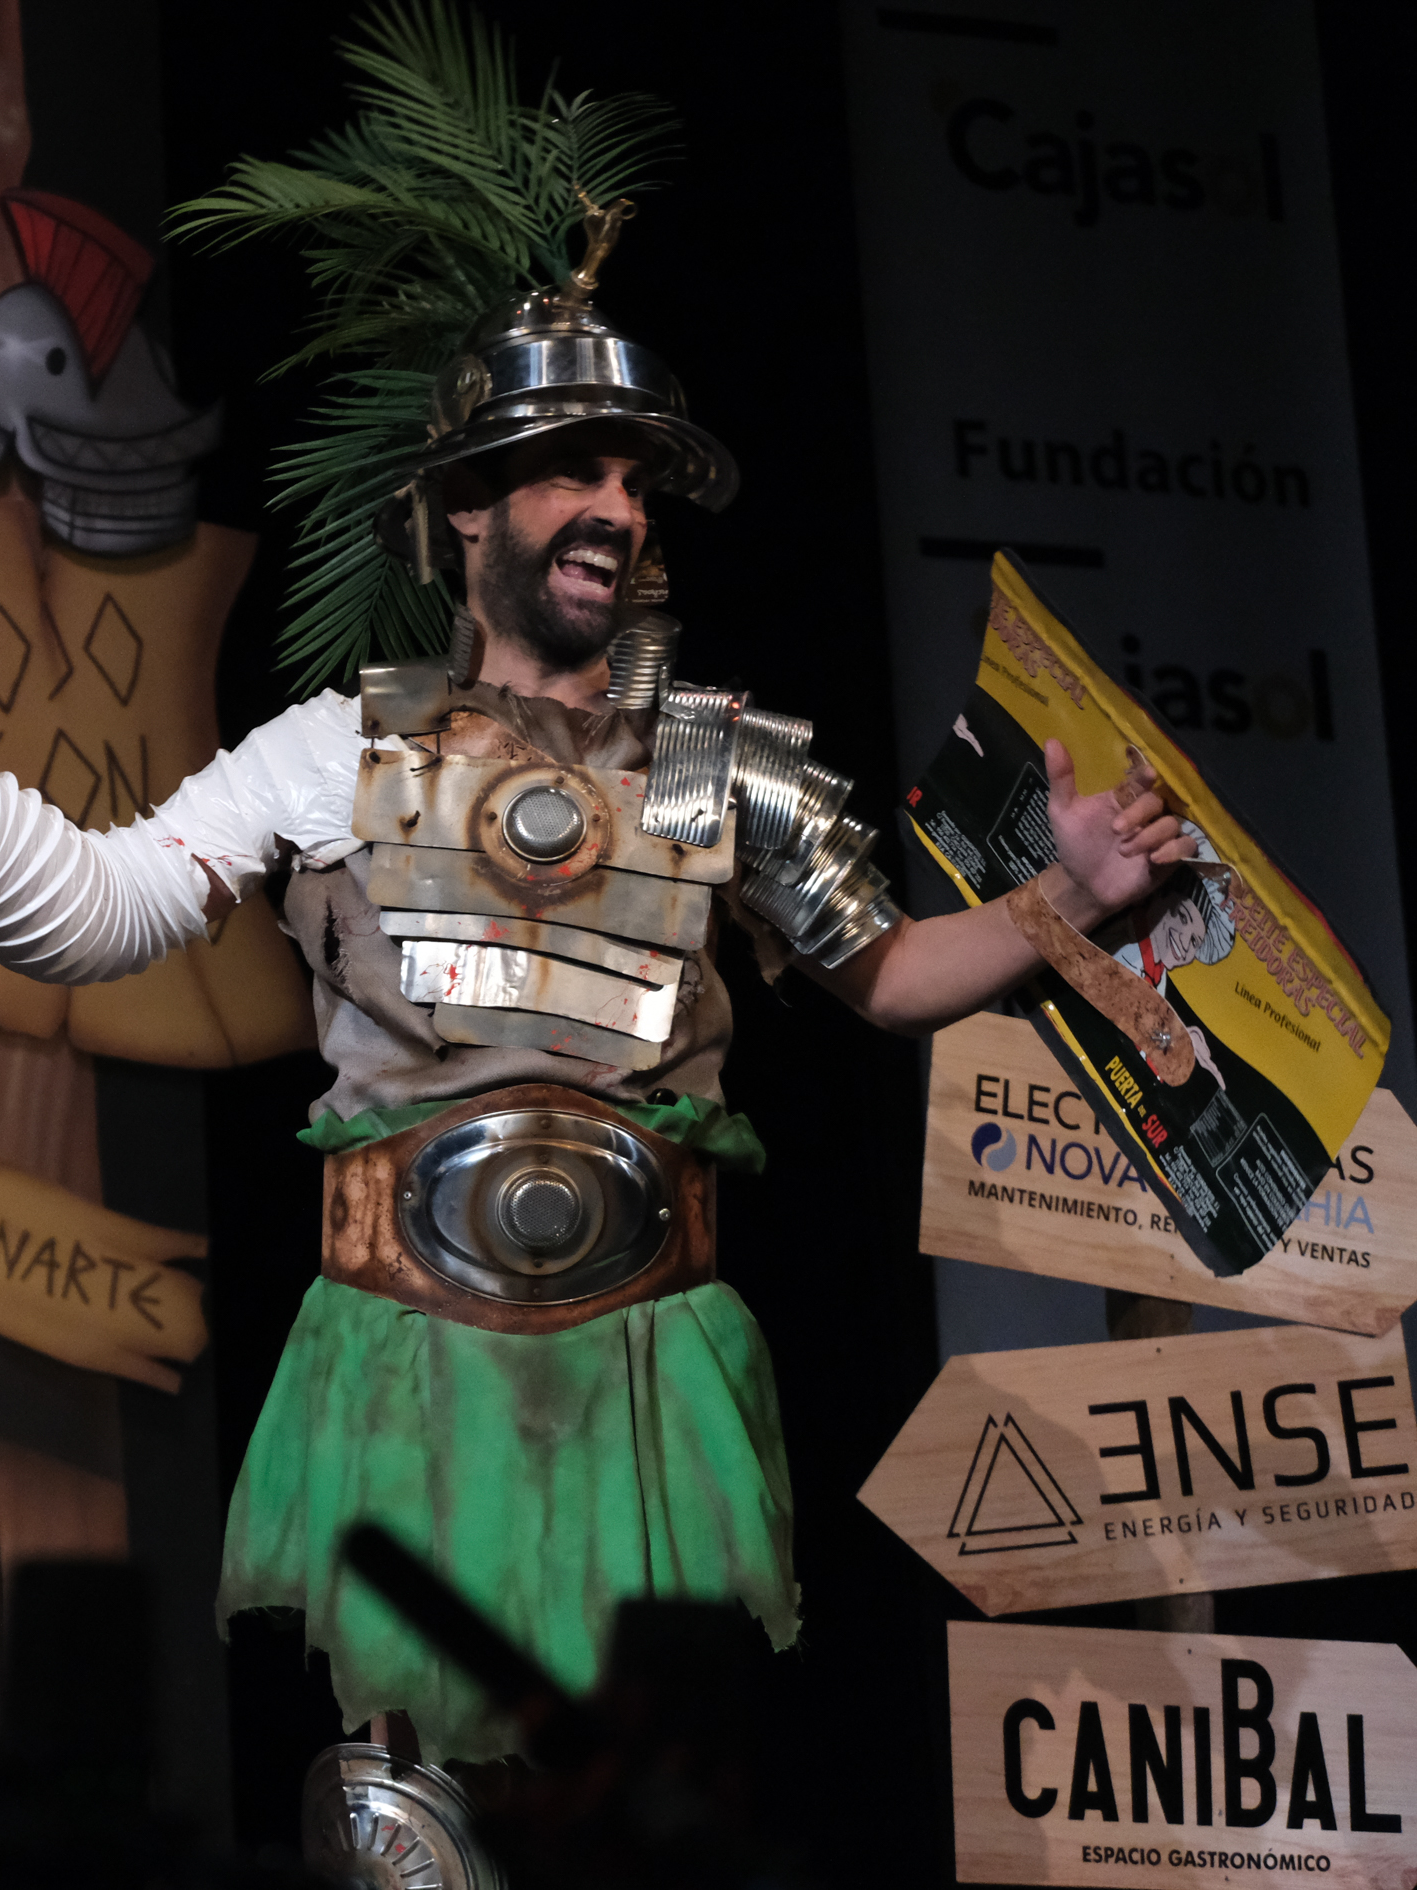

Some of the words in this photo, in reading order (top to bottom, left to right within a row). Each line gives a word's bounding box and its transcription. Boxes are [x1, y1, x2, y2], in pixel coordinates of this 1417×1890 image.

[946, 95, 1286, 228] Cajasol
[953, 418, 1310, 510] Fundación
[1219, 890, 1315, 1017] FREIDORAS
[1234, 876, 1290, 953] CEITE
[1286, 946, 1367, 1060] ESPECIAL
[1263, 1000, 1322, 1053] Profesional
[1104, 1055, 1144, 1110] PUERTA
[1141, 1113, 1169, 1149] SUR
[967, 1180, 1143, 1230] MANTENIMIENTO,
[1296, 1241, 1371, 1269] VENTAS
[1296, 1190, 1375, 1234] HIA
[1103, 1507, 1222, 1541] ENERGÍA
[1234, 1508, 1248, 1527] Y
[1261, 1490, 1416, 1525] SEGURIDAD
[1002, 1658, 1403, 1834] CANIBAL
[1081, 1844, 1162, 1869] ESPACIO
[1168, 1847, 1333, 1873] GASTRONÓMICO
